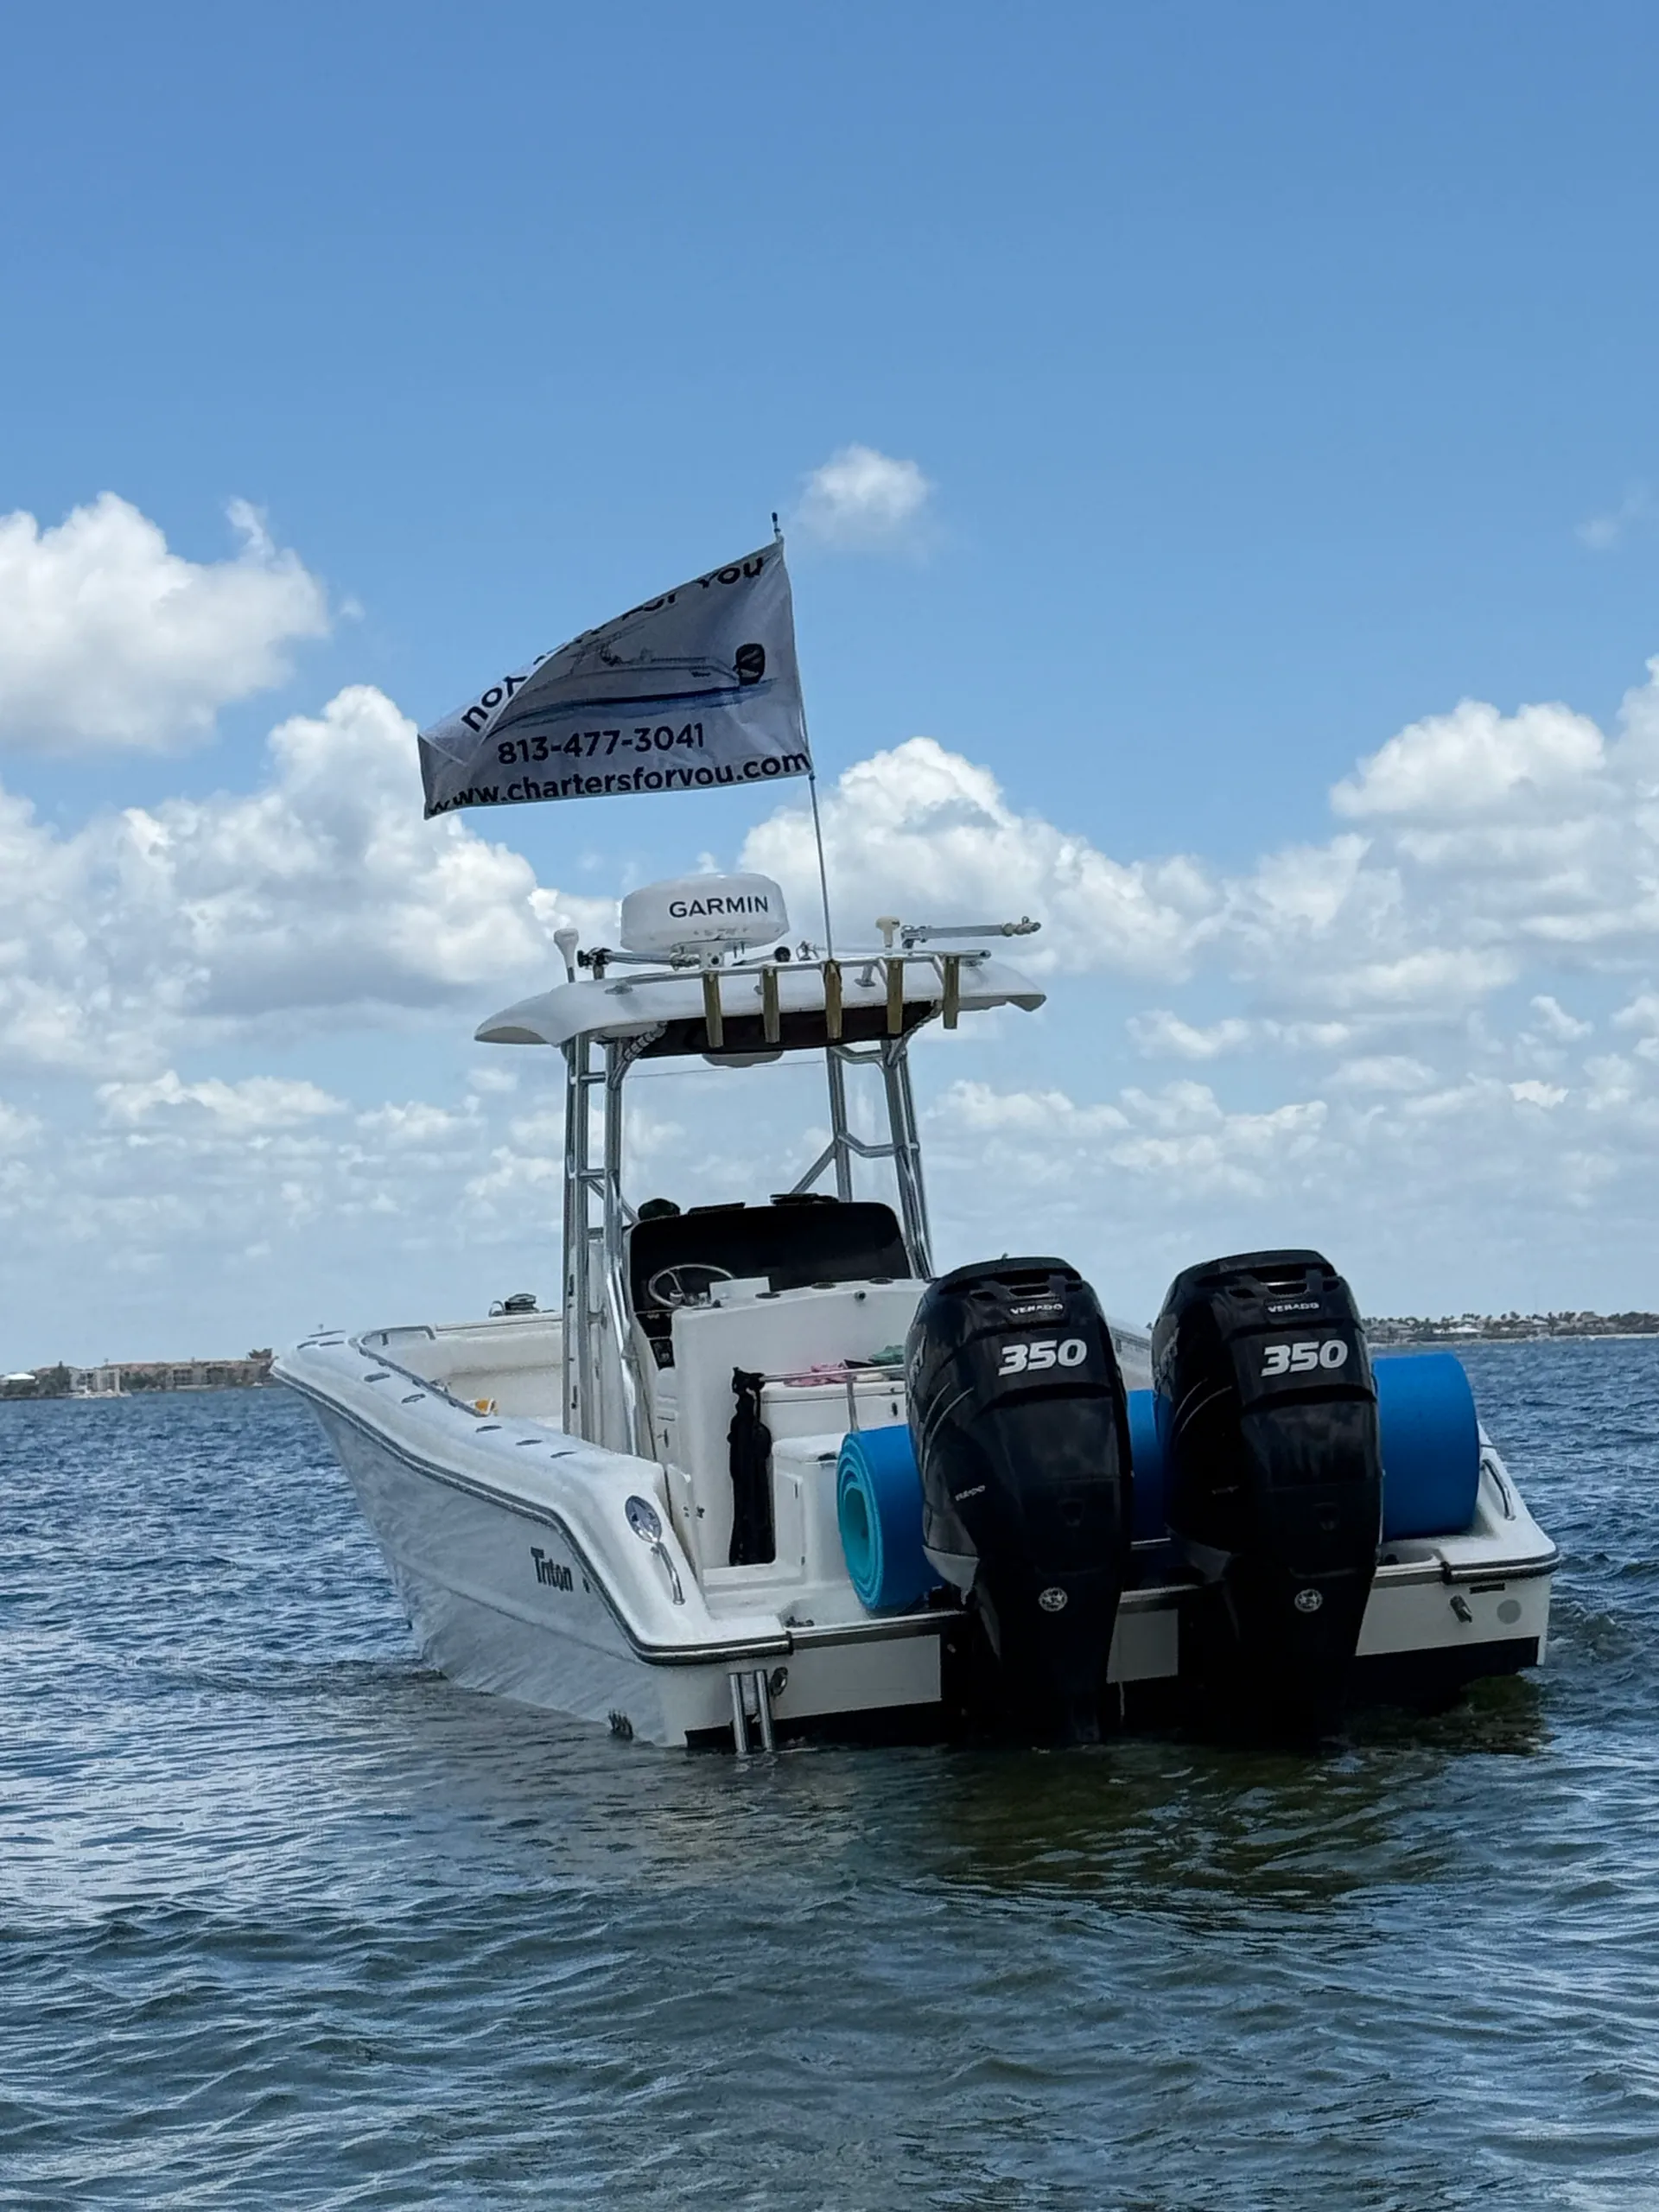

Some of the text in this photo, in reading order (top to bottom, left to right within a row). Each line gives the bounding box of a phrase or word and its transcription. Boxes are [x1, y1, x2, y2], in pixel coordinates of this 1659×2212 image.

[497, 722, 704, 766] 813-477-3041
[669, 895, 768, 918] GARMIN
[1009, 1303, 1064, 1315] VERADO
[1267, 1302, 1320, 1313] VERADO
[998, 1338, 1088, 1376] 350
[1260, 1339, 1349, 1377] 350
[530, 1546, 574, 1592] Triton
